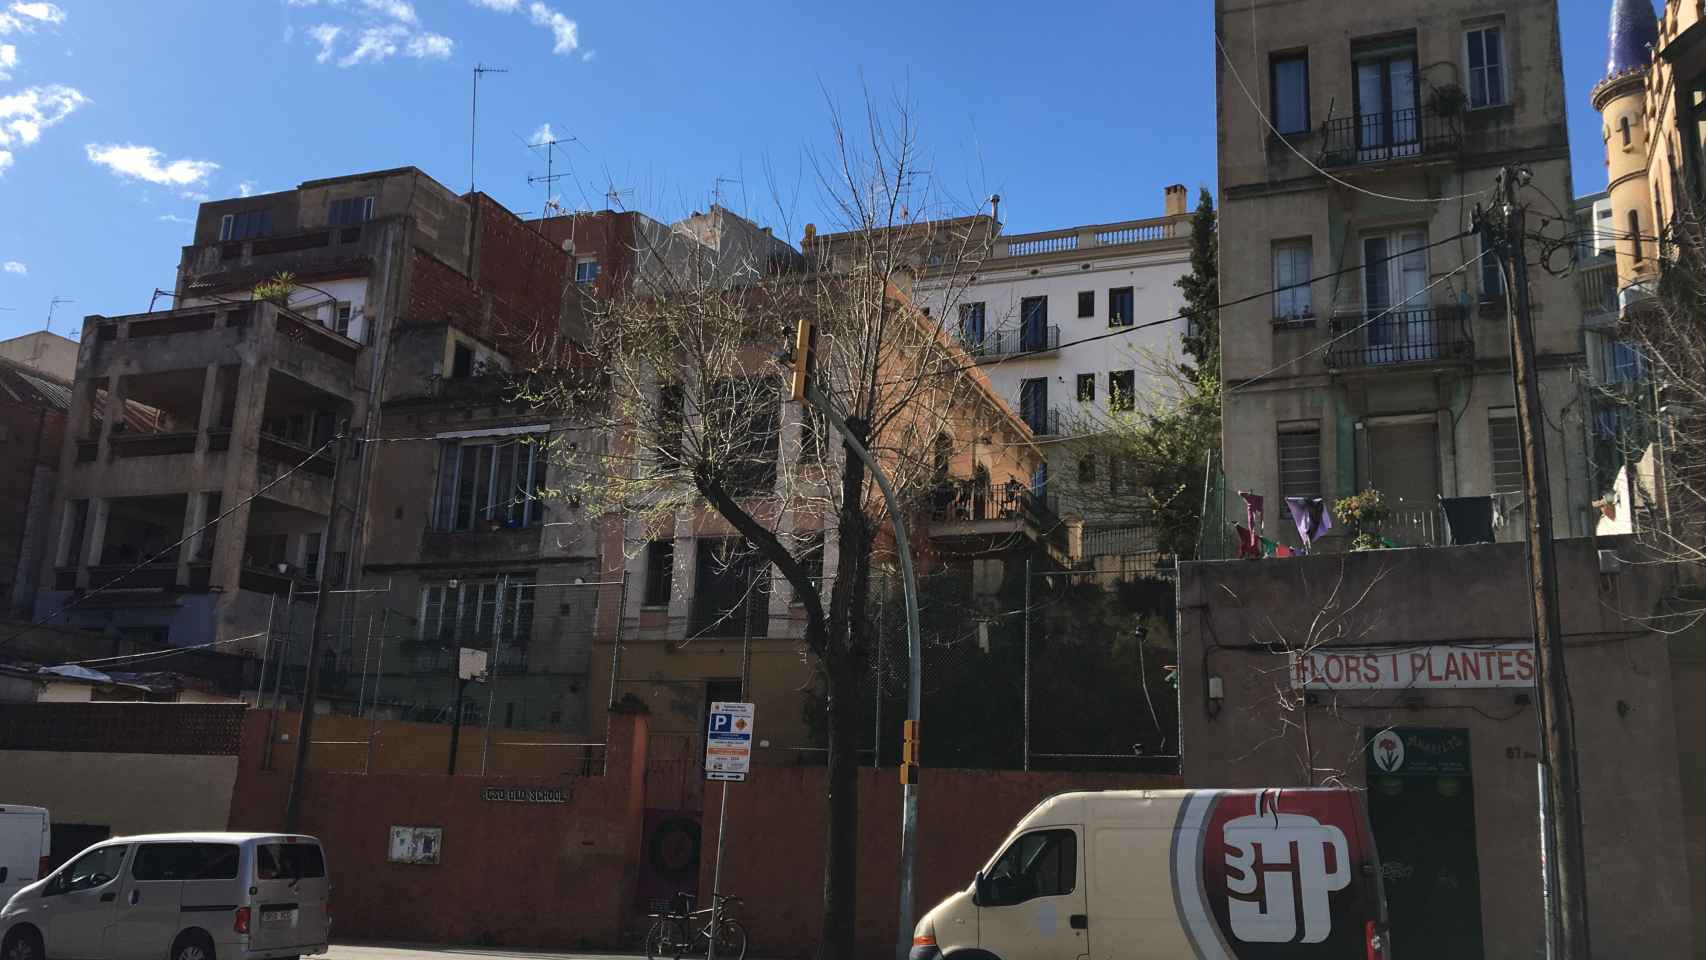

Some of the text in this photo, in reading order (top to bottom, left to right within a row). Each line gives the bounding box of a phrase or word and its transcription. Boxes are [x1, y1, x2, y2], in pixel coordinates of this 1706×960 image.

[1296, 650, 1535, 684] FLORS I PLANTES
[715, 715, 727, 730] P
